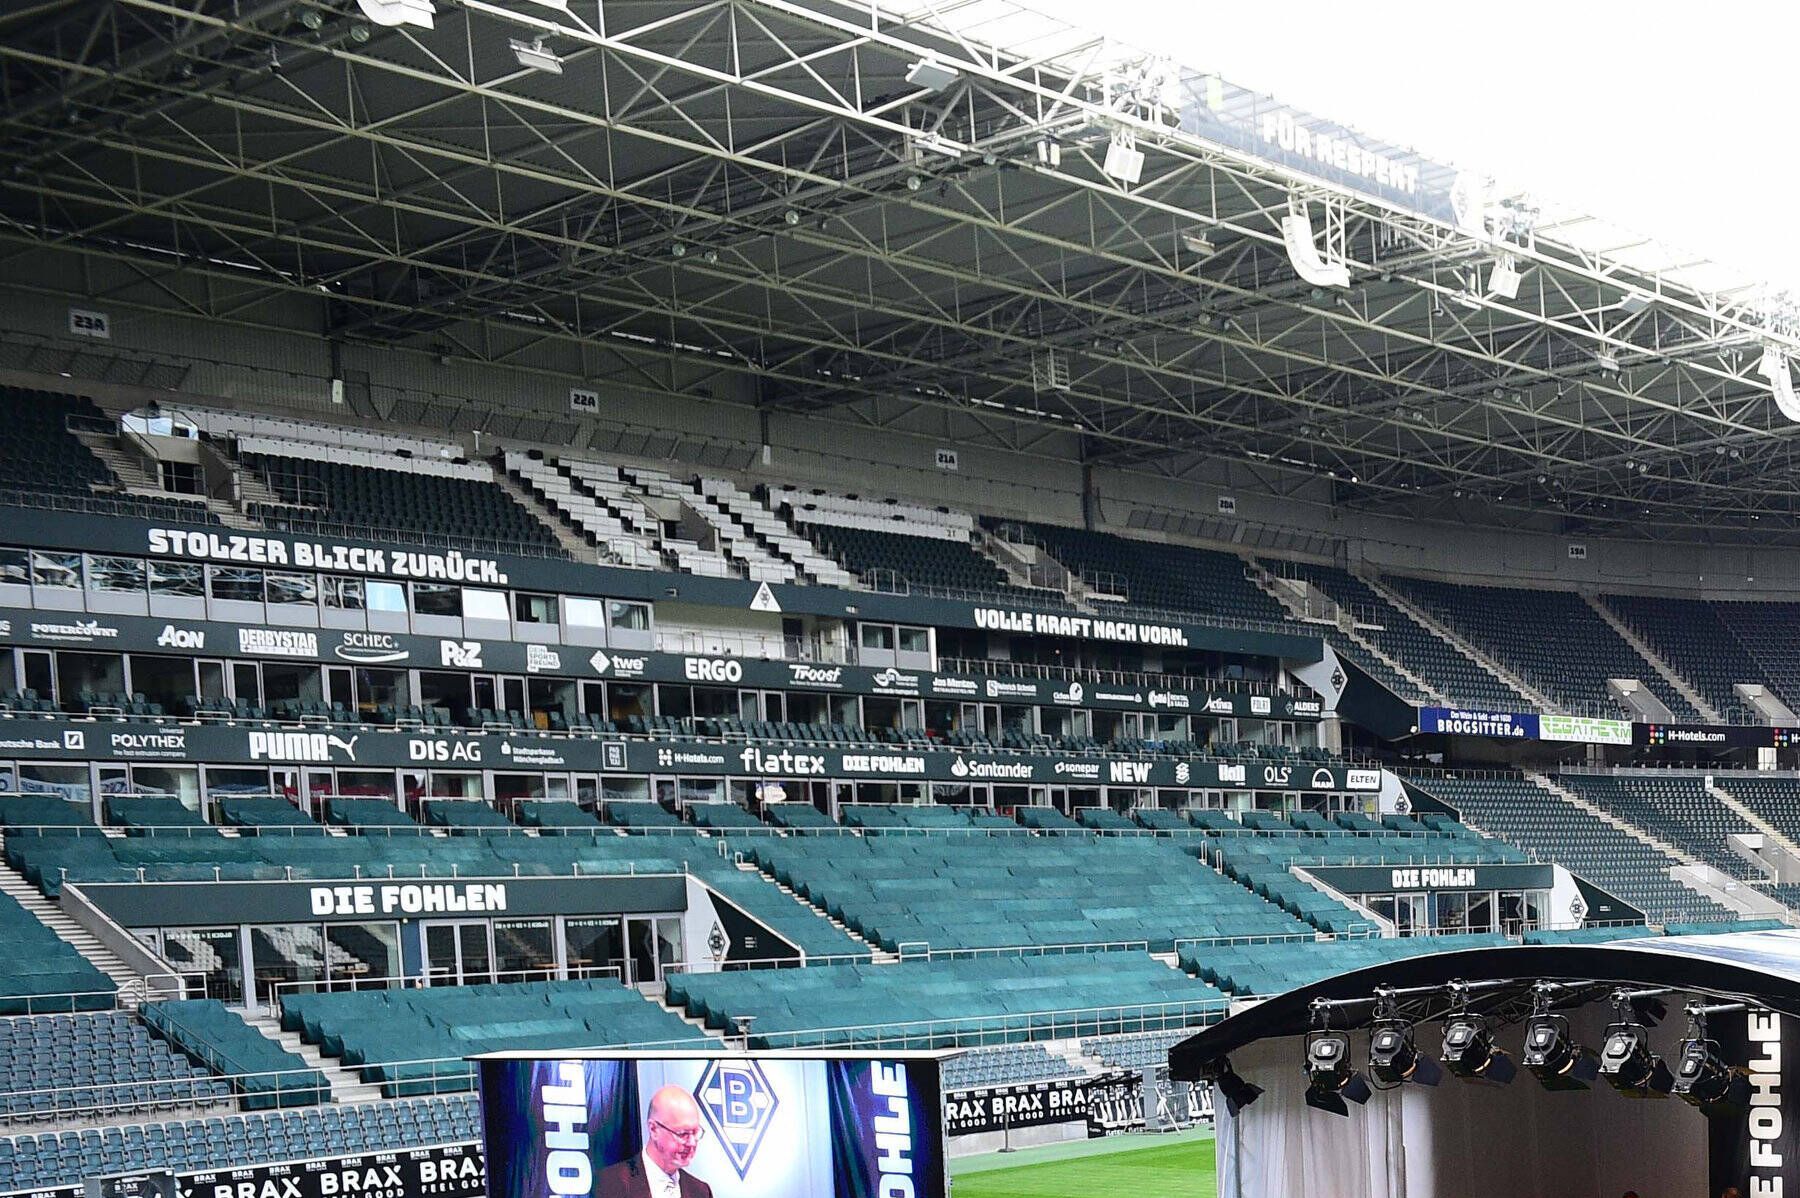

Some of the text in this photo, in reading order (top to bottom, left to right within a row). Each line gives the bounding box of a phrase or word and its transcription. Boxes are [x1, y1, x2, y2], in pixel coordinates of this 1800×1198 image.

[73, 314, 106, 332] 23A
[572, 393, 597, 408] 22A
[149, 529, 508, 585] STOLZER BLICK ZURÜCK.
[974, 608, 1188, 647] VOLLE KRAFT NACH VORN.
[239, 629, 317, 650] DERBYSTAR
[611, 655, 645, 671] twe
[685, 658, 742, 682] ERGO
[1294, 701, 1320, 712] ALDERS
[1438, 719, 1524, 737] BROGSITTER.de
[1668, 730, 1726, 743] H-Hotels.com
[111, 733, 186, 749] POLYTHEX
[409, 740, 481, 761] DIS AG
[674, 752, 725, 764] H-Hotels.com
[740, 747, 826, 774] flatex
[843, 756, 925, 773] DIE FOHLEN
[969, 760, 1034, 778] Santander
[1066, 763, 1100, 774] sonepar
[1350, 775, 1377, 784] ELTEN
[1392, 868, 1476, 888] DIE FOHLEN
[310, 884, 507, 915] DIE FOHLEN
[1747, 1007, 1783, 1168] FOHLE
[947, 1099, 986, 1120] RAX
[992, 1092, 1043, 1116] BRAX
[1050, 1107, 1072, 1117] FEEL
[1020, 1111, 1044, 1121] GOOD
[320, 1165, 403, 1195] BRAX
[421, 1182, 455, 1194] FEEL
